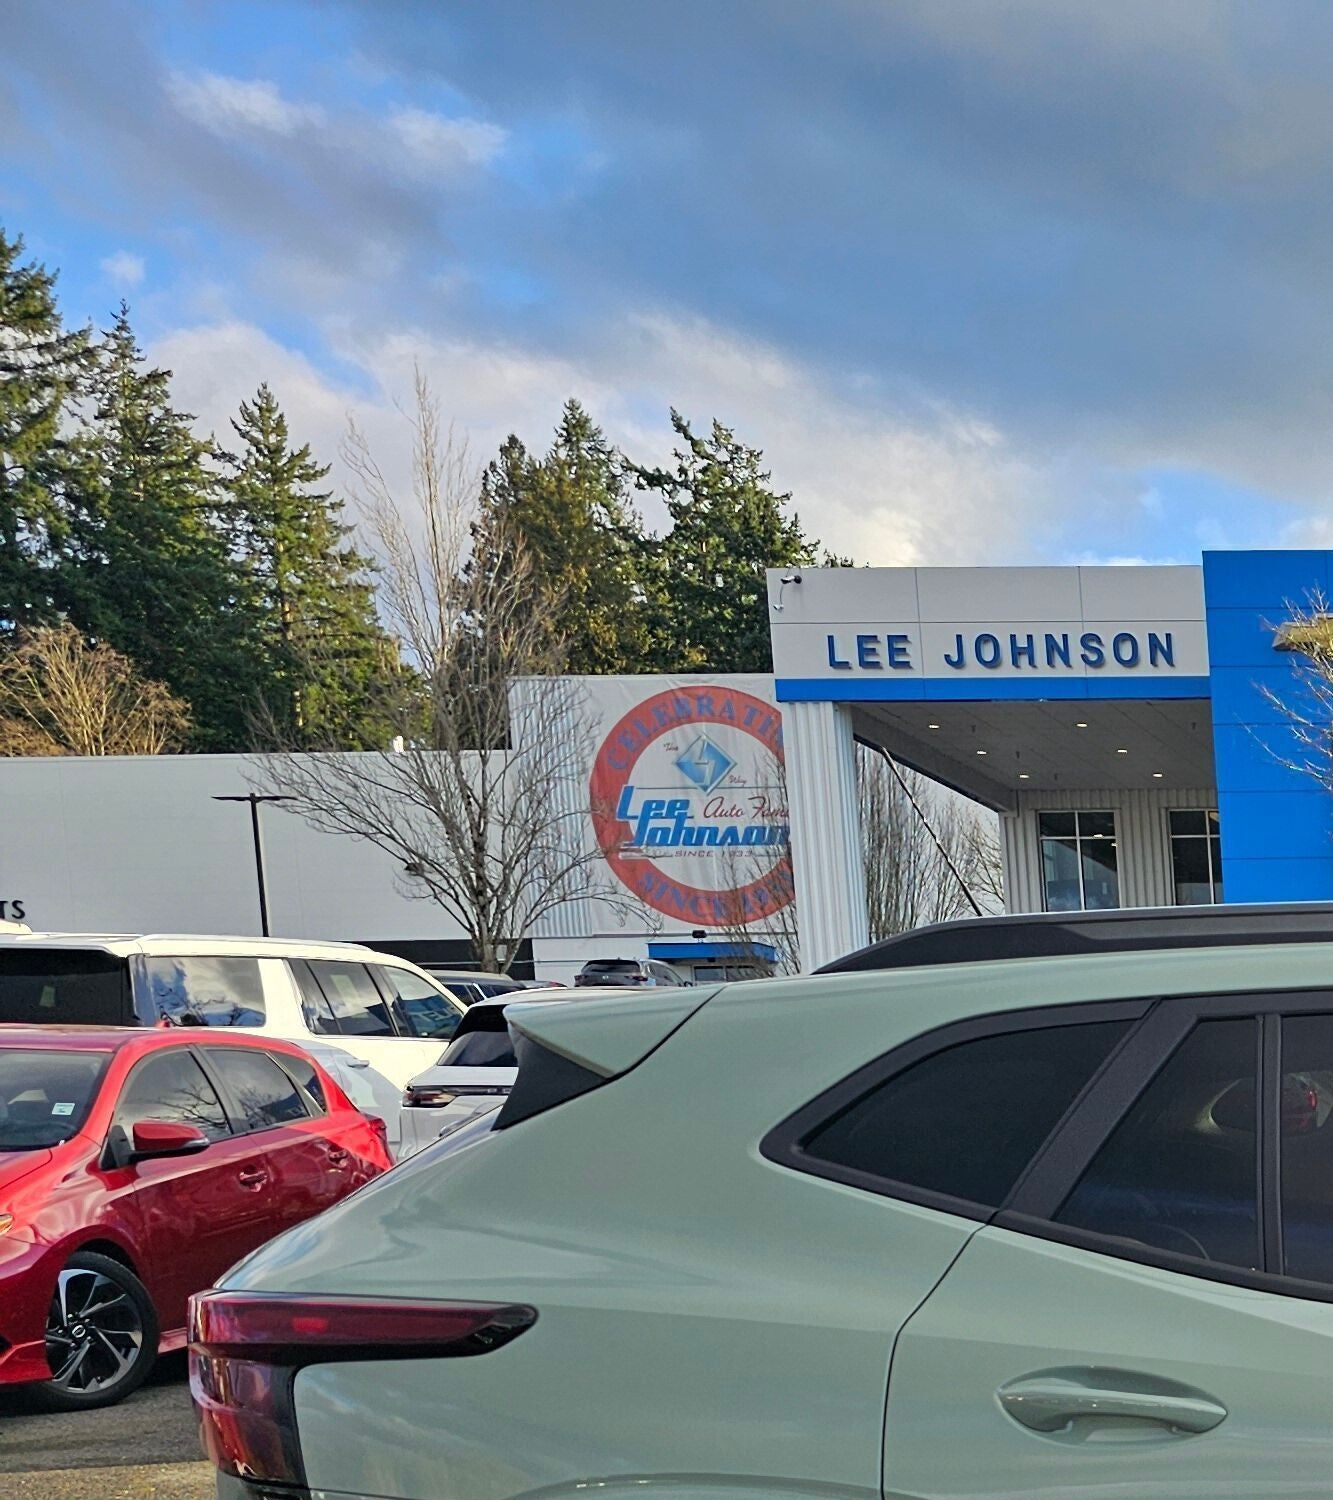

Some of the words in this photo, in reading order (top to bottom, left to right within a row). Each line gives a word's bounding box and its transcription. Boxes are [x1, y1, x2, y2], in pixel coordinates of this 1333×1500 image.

[827, 634, 913, 669] LEE
[944, 632, 1175, 669] JOHNSON
[616, 785, 694, 819] Lee
[703, 796, 744, 818] Auto
[631, 799, 791, 847] Johnson
[674, 849, 713, 857] SINCE
